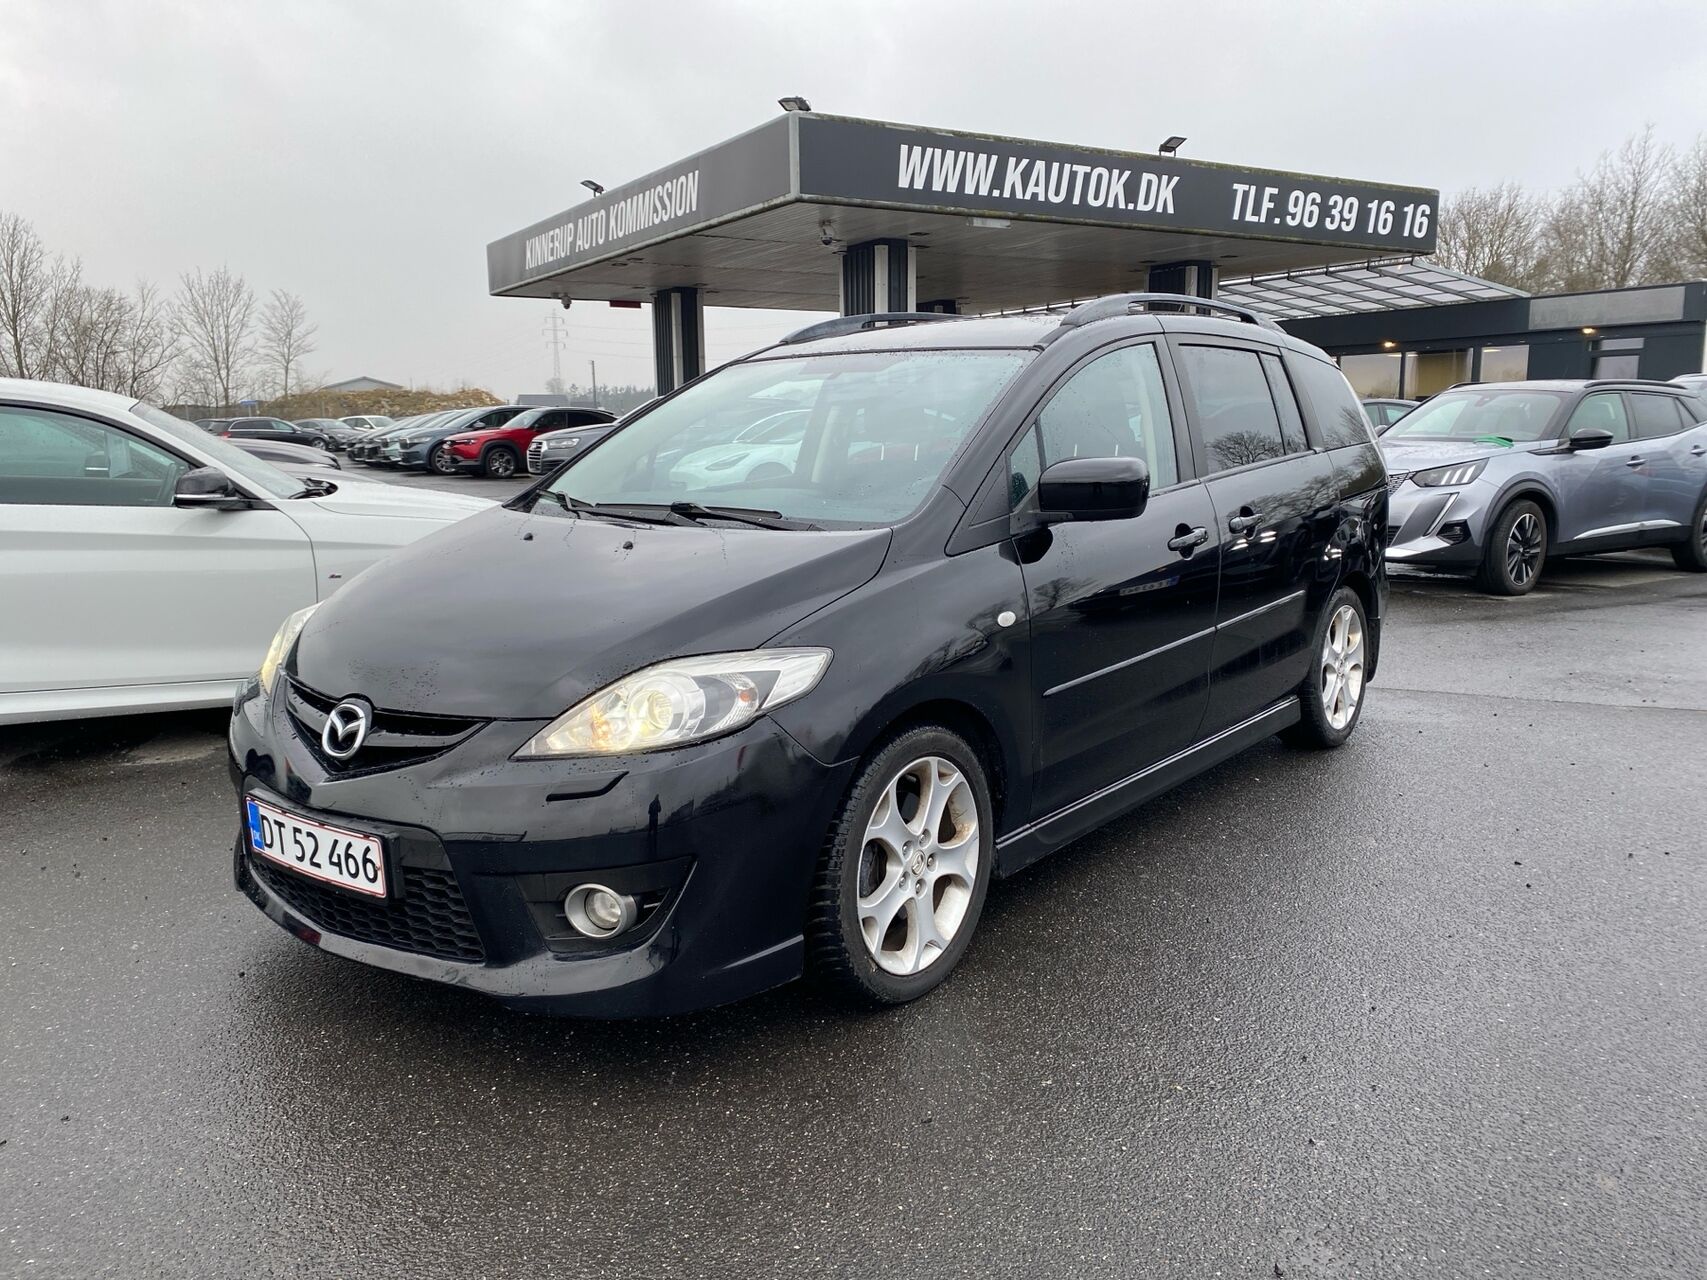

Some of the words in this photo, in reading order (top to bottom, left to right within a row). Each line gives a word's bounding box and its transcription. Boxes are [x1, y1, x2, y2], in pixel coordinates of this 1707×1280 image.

[897, 144, 1180, 214] WWW.KAUTOK.DK
[1232, 183, 1280, 225] TLF.
[1287, 189, 1321, 229] 96
[1325, 194, 1359, 233] 39
[1367, 200, 1396, 236] 16
[1403, 204, 1431, 239] 16
[526, 222, 574, 270] KINNERUP
[576, 209, 606, 252] AUTO
[609, 170, 699, 241] KOMMISSION
[261, 814, 287, 856] DT
[293, 828, 322, 870] 52
[328, 839, 379, 884] 466
